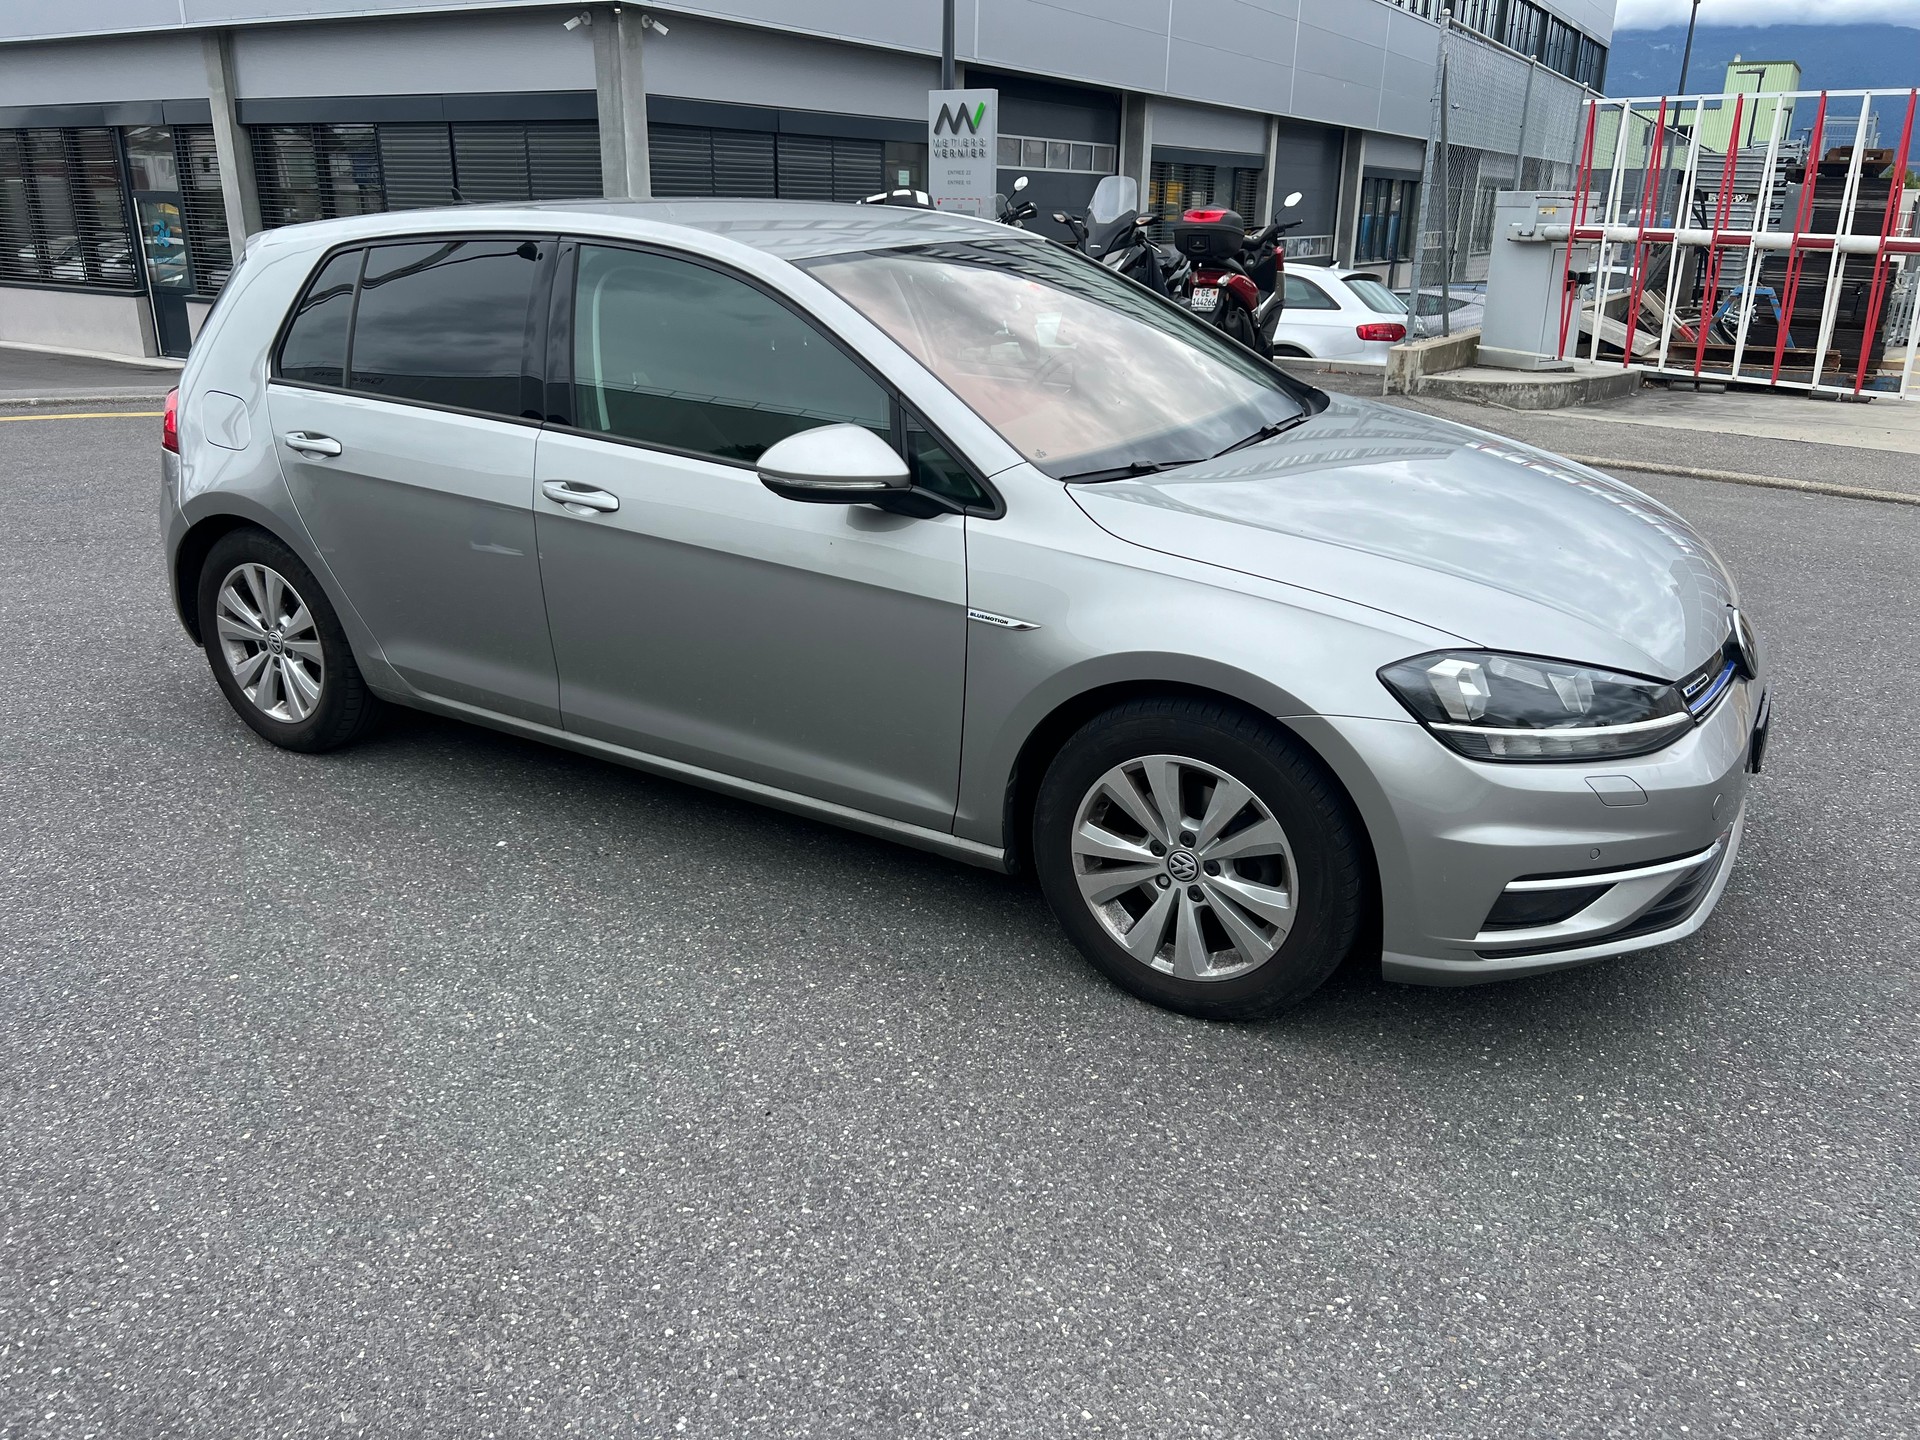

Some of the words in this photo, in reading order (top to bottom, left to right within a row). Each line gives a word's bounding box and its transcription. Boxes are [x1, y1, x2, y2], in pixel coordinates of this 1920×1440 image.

[933, 148, 986, 158] VERNIER
[1201, 289, 1210, 297] GE
[1192, 298, 1216, 306] 144266
[969, 611, 1009, 625] BLUEMOTION
